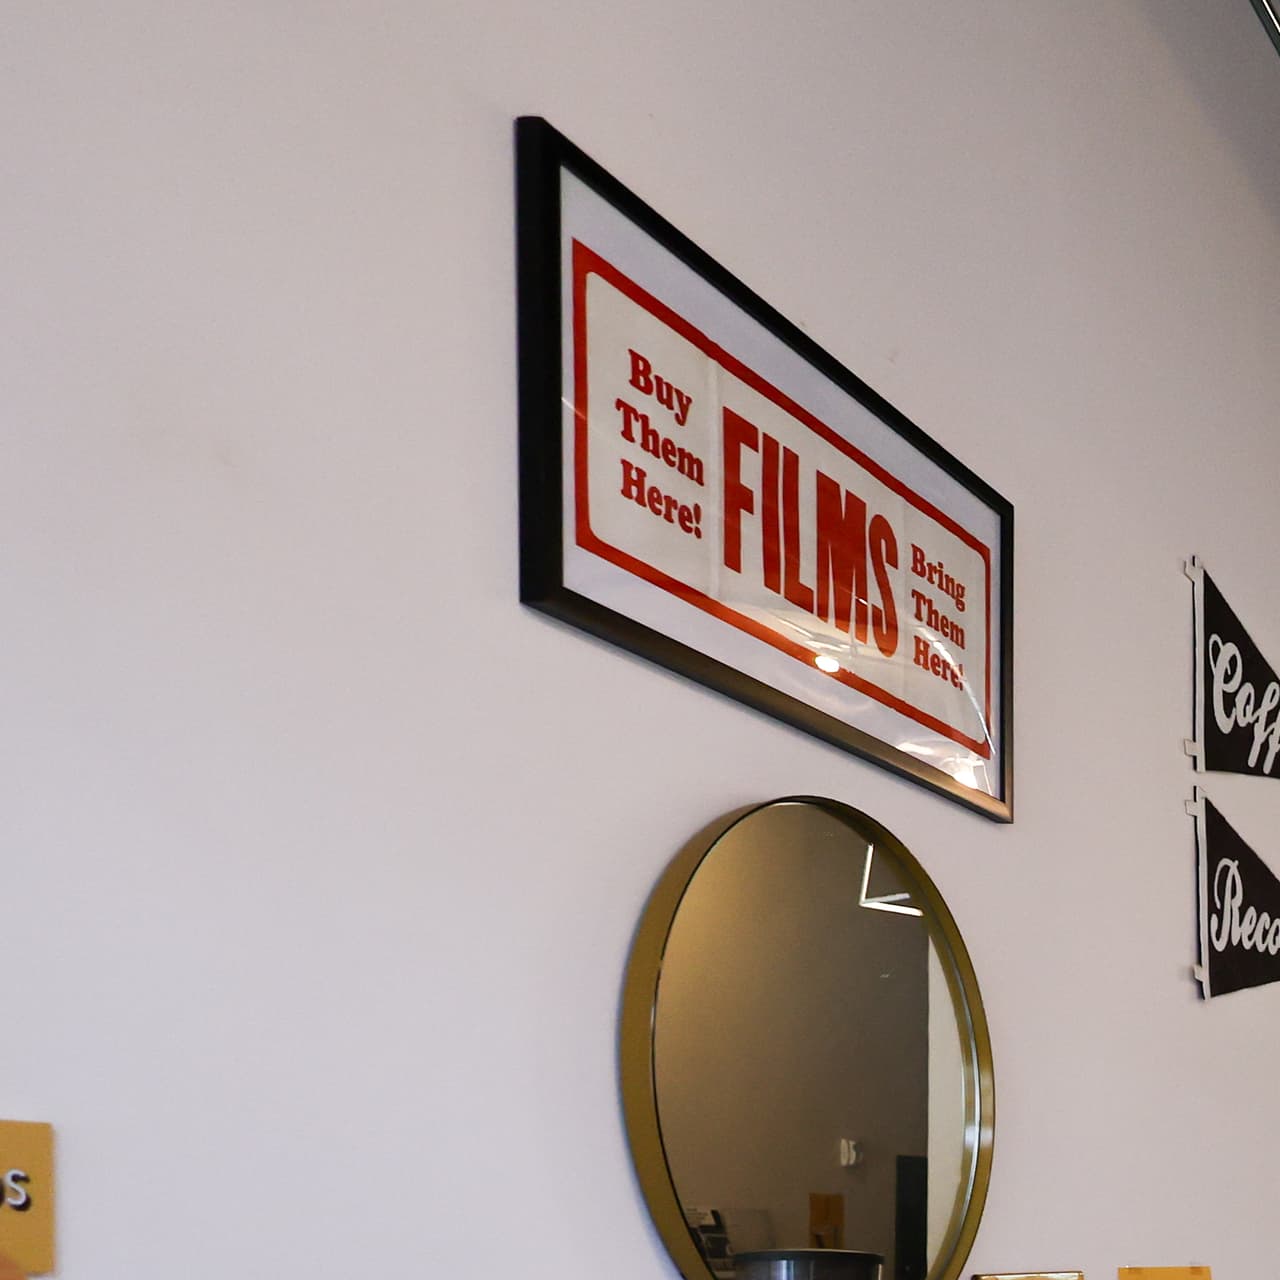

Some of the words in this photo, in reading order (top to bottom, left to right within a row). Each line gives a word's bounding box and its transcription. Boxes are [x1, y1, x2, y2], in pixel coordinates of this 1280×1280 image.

[628, 348, 692, 426] Buy
[615, 398, 704, 487] Them
[620, 458, 702, 539] Here!
[722, 406, 900, 659] FILMS
[911, 543, 966, 612] Bring
[911, 589, 966, 650] Them
[913, 635, 964, 691] Here!
[0, 1168, 31, 1213] S
